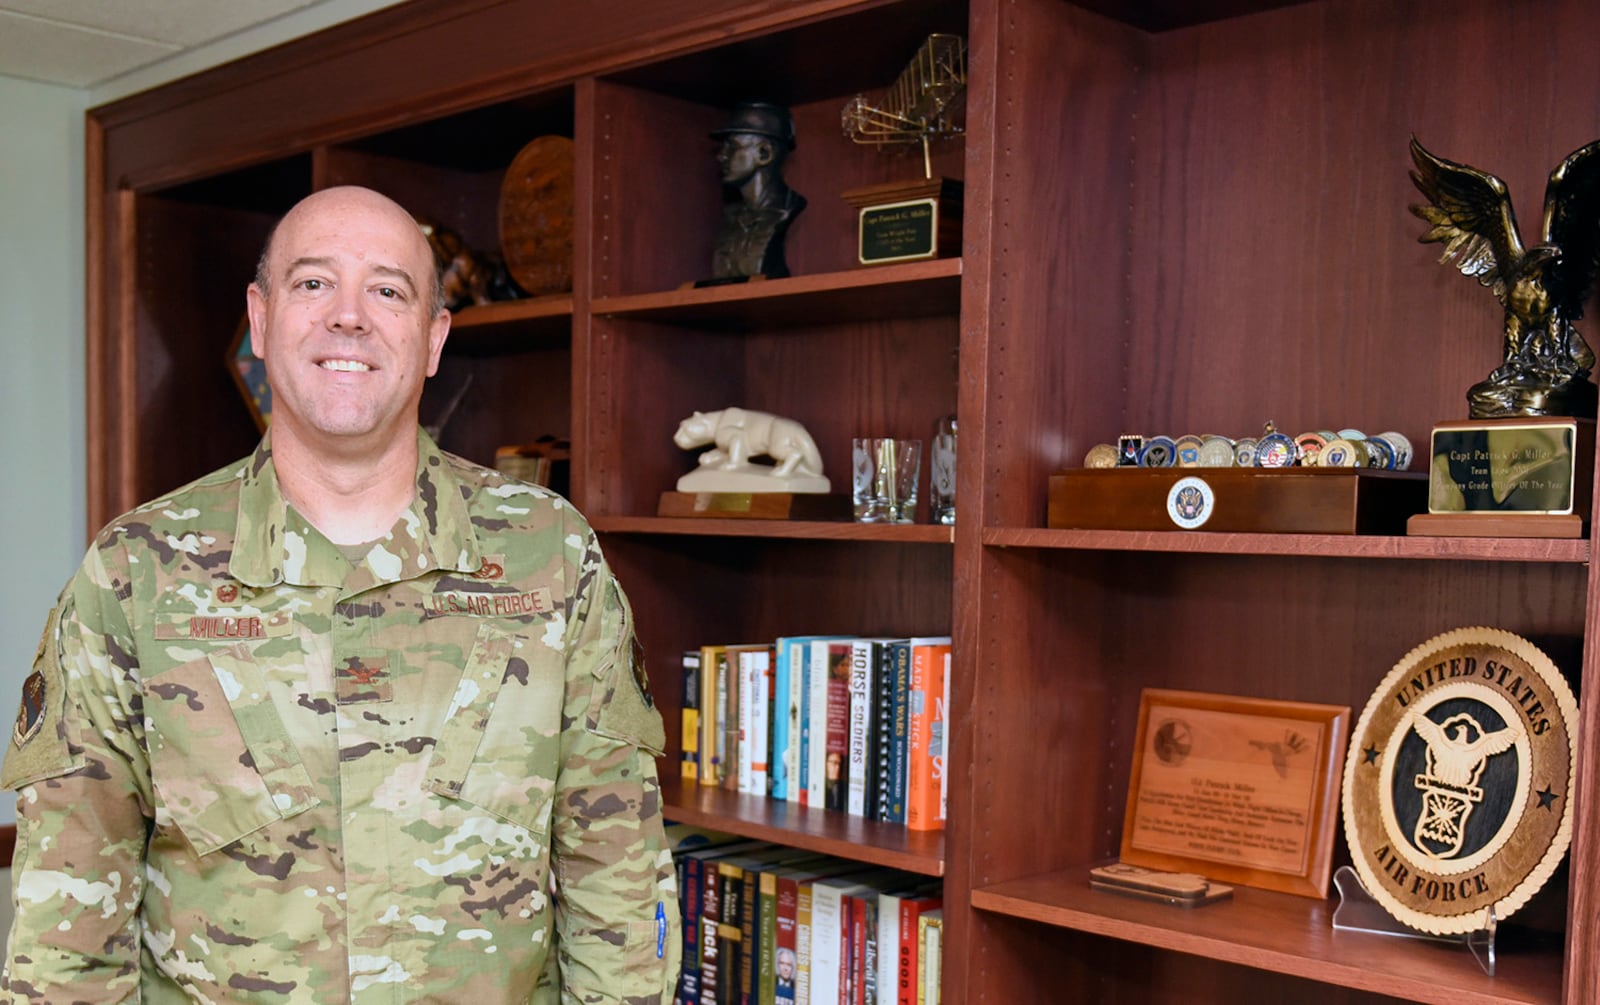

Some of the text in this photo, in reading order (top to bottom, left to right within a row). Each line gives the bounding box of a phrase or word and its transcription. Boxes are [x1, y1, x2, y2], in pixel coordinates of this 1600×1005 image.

[1450, 450, 1471, 462] Capt
[1474, 449, 1508, 461] Patrick
[1525, 449, 1550, 459] Miller
[1471, 466, 1489, 475] Team
[1468, 480, 1489, 490] Grade
[1531, 480, 1544, 489] The
[431, 591, 543, 616] U.S. AIR FORCE
[189, 616, 261, 638] MILLER
[853, 648, 867, 700] HORSE
[897, 647, 907, 703] OBAMA'S
[912, 655, 922, 691] MADE
[1395, 656, 1552, 737] UNITED STATES
[853, 704, 865, 764] SOLDIERS
[896, 705, 905, 737] WARS
[911, 711, 921, 750] STICK
[1374, 844, 1490, 902] AIR FORCE
[702, 916, 719, 958] jack
[762, 916, 771, 935] Year
[761, 949, 770, 976] IRAQ
[865, 939, 877, 982] Liberal
[900, 946, 910, 989] GOOD
